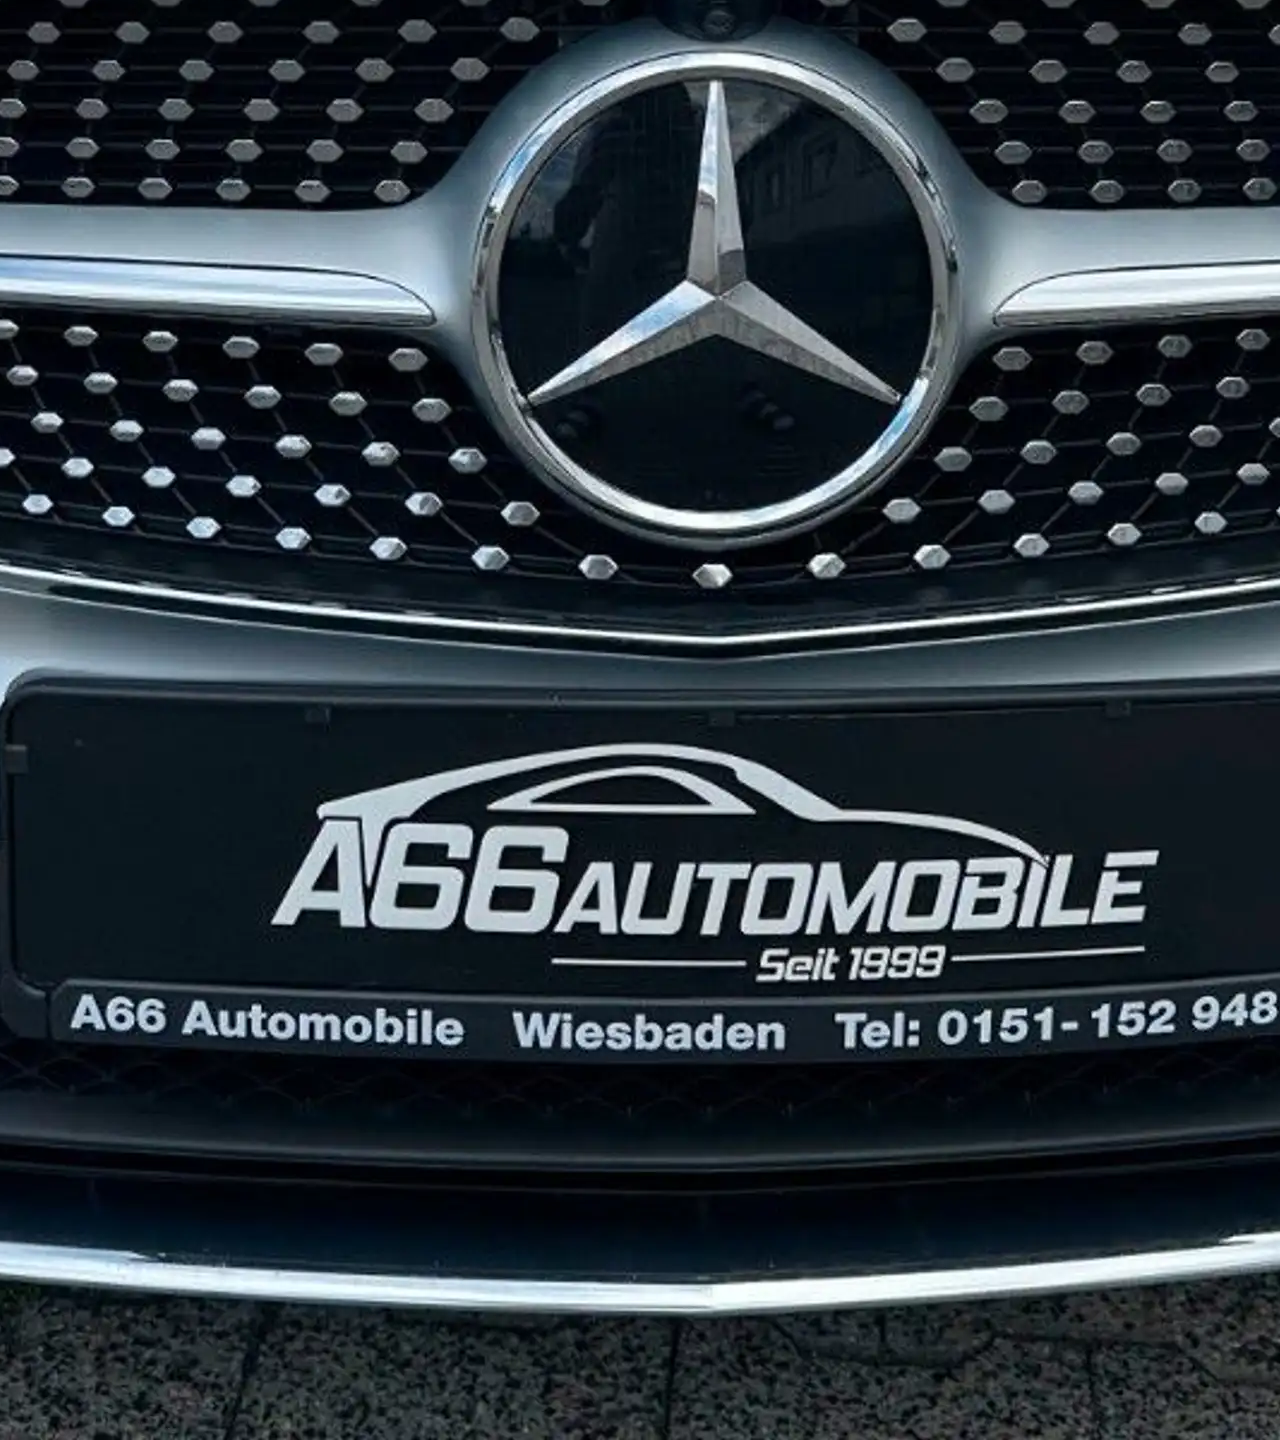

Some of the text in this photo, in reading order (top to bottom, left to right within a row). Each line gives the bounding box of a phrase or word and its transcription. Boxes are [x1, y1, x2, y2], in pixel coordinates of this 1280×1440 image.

[754, 944, 947, 983] Seit 1999
[69, 993, 167, 1034] A66
[180, 999, 465, 1047] Automobile
[511, 1010, 786, 1051] Wiesbaden
[833, 1010, 921, 1050] Tel:
[1191, 989, 1279, 1031] 948
